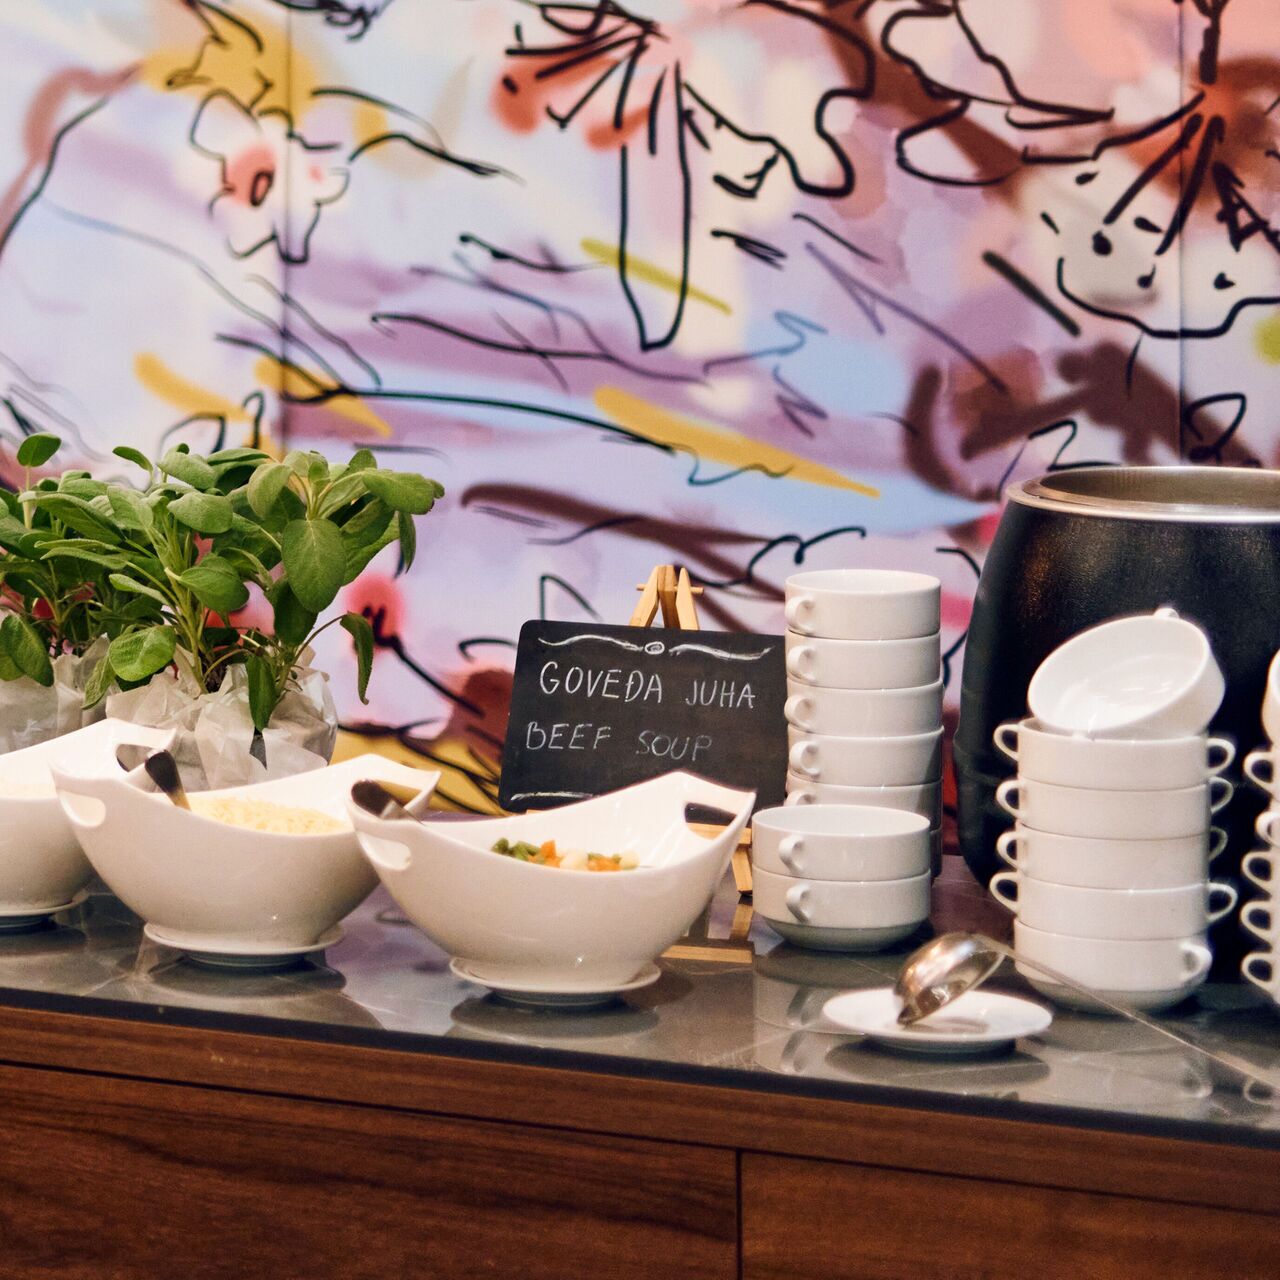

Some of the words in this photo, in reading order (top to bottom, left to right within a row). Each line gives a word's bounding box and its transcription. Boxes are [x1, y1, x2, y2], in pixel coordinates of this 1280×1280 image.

[686, 680, 756, 708] JUHA
[526, 721, 611, 750] BEEF
[636, 730, 712, 762] SOUP
